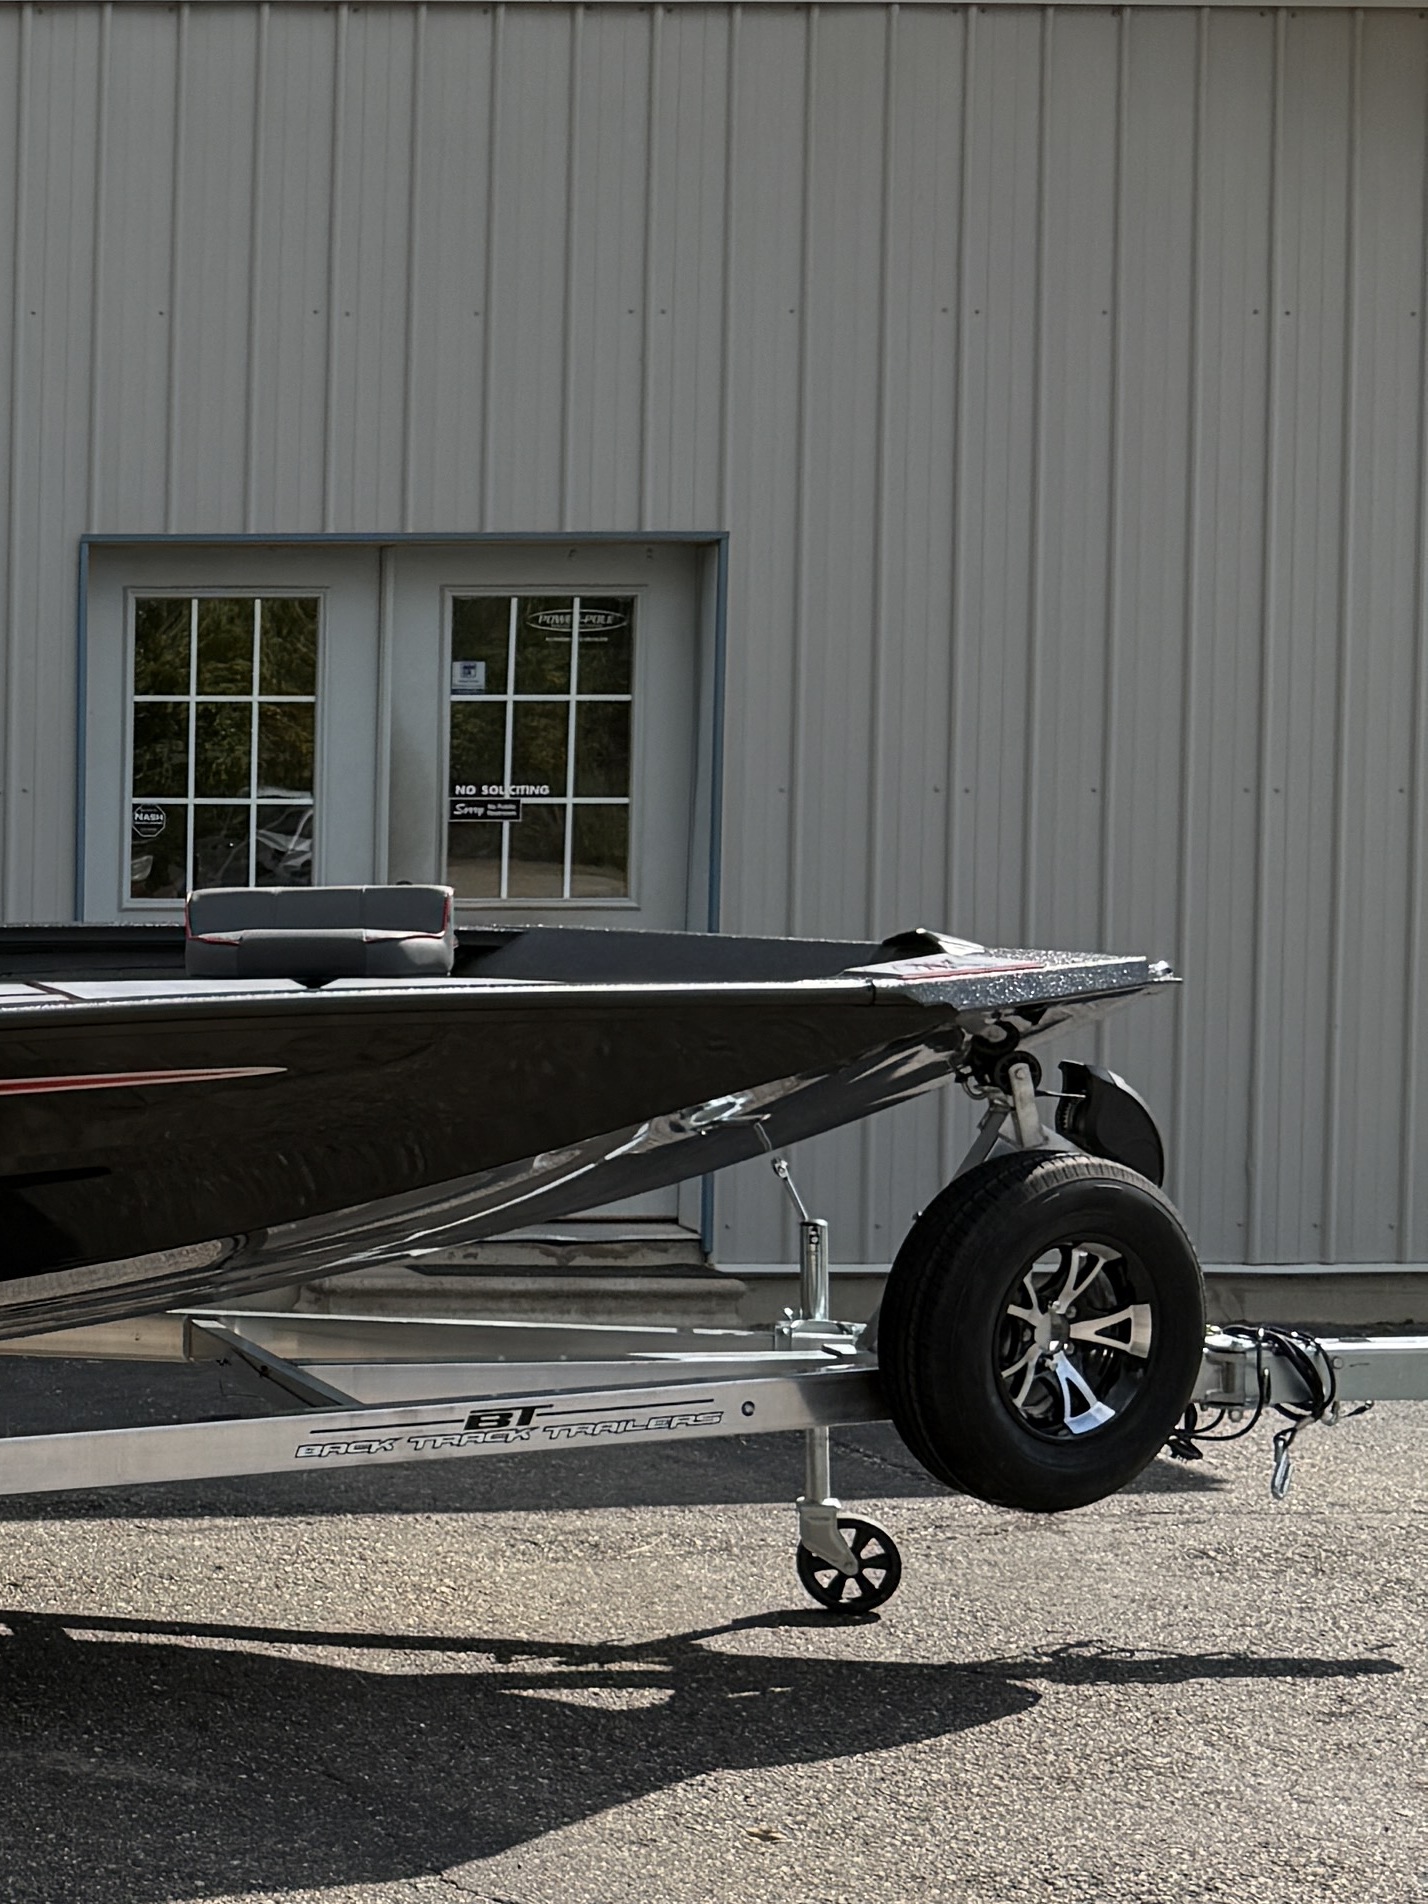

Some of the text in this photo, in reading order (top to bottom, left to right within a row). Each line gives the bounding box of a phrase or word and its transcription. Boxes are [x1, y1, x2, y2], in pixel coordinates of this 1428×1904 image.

[455, 785, 550, 795] NO SOLCITING
[295, 1410, 724, 1459] BACK TRACK TRAILERS
